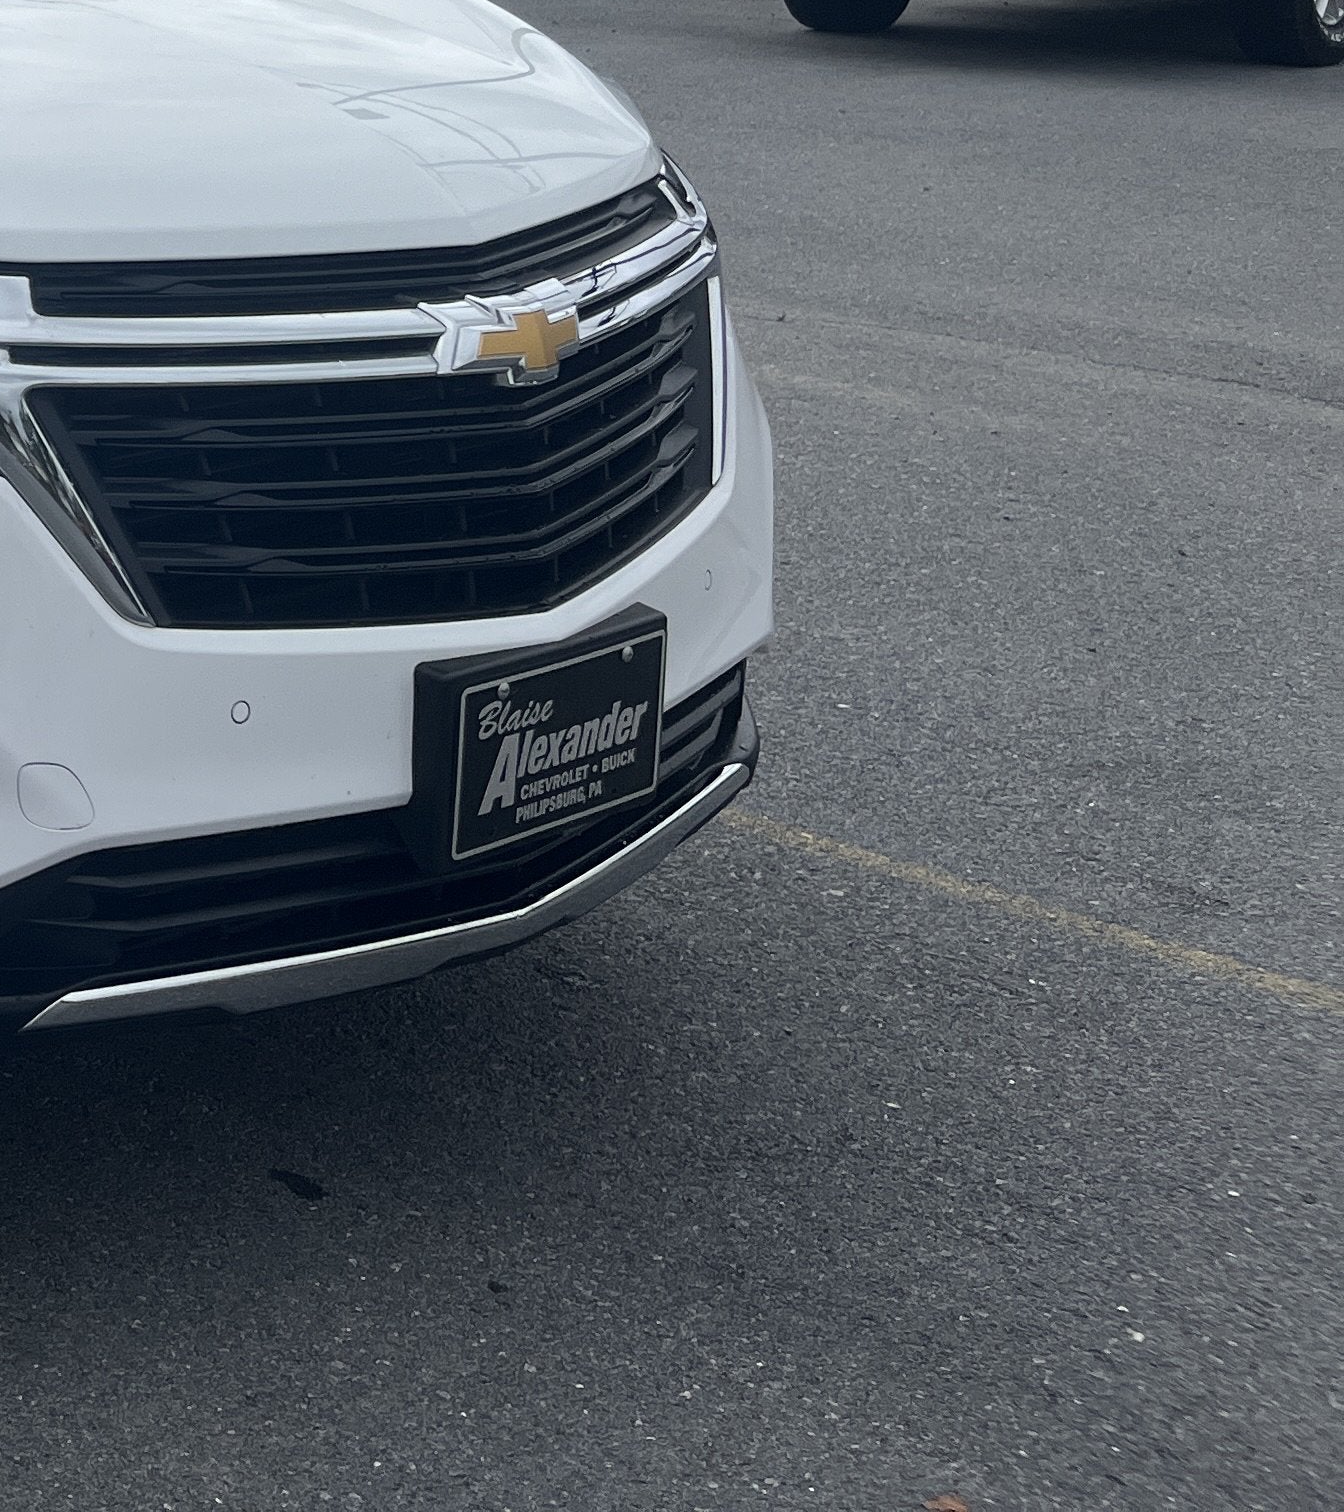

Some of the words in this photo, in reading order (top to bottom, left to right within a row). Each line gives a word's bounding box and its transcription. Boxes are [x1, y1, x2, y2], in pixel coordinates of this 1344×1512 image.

[478, 700, 554, 740] Blaise
[478, 701, 649, 816] Alexander
[520, 764, 589, 801] CHEVROLET
[601, 747, 637, 774] BUICK
[588, 780, 603, 799] PA
